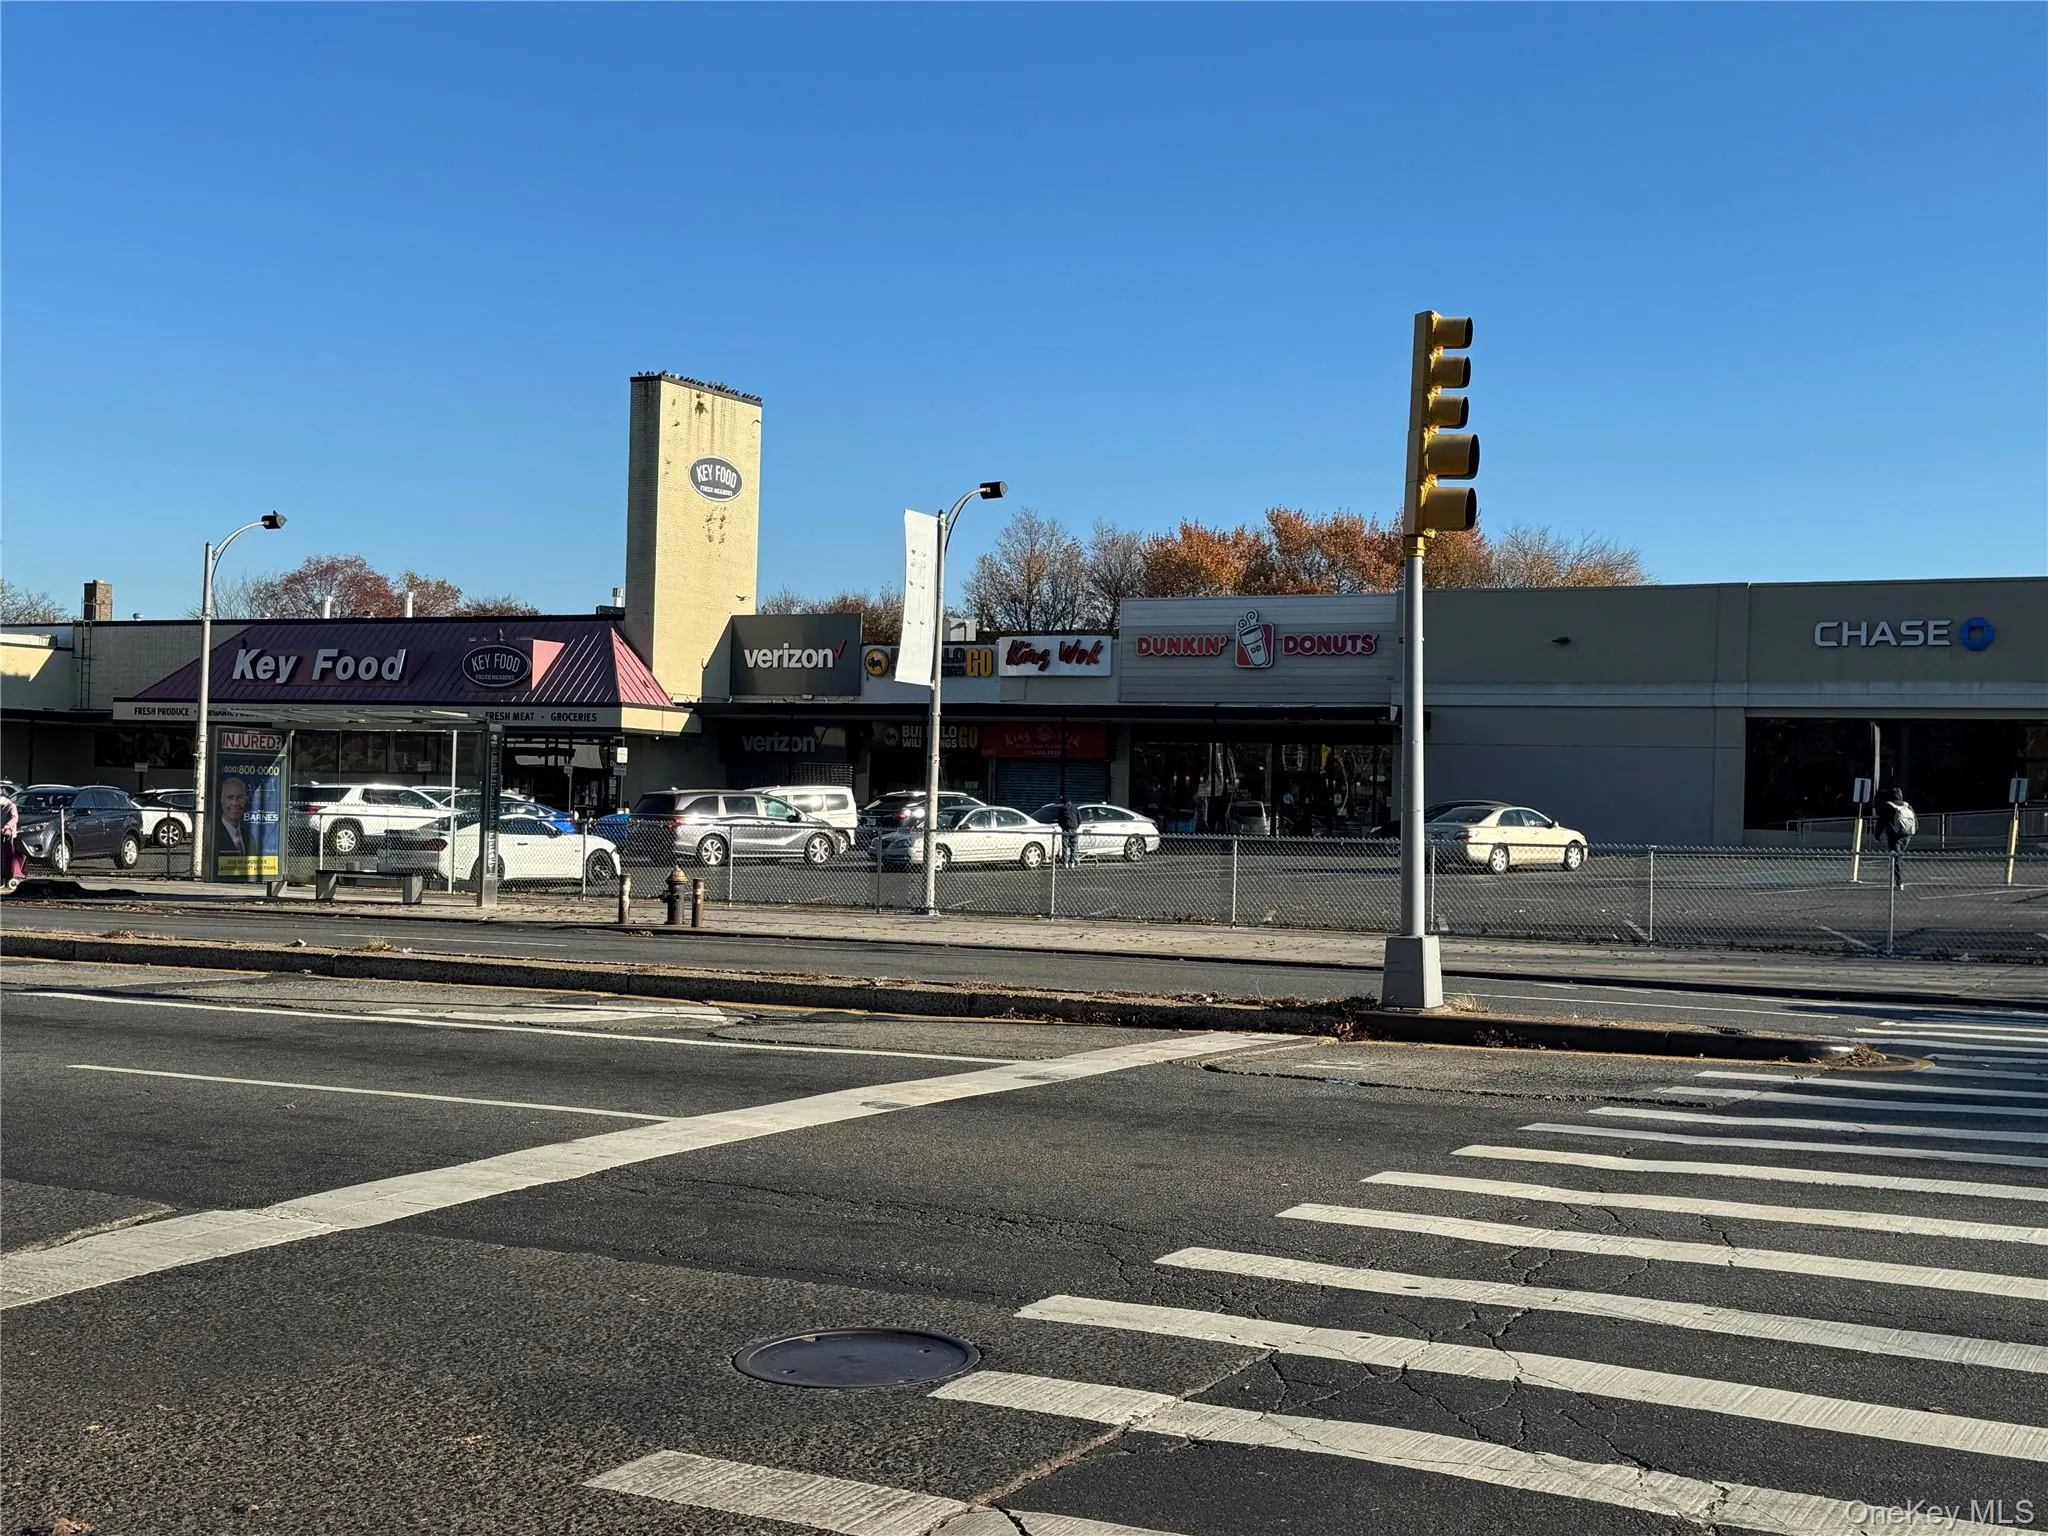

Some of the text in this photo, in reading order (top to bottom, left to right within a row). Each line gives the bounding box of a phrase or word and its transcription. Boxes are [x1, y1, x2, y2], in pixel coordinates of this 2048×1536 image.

[696, 464, 737, 488] KEY FOOD
[1136, 633, 1378, 656] DUNKIN' DONUTS
[1814, 620, 1952, 647] CHASE
[232, 648, 407, 684] Key Food
[471, 653, 520, 673] KEY FOOD
[743, 642, 834, 669] verizon
[966, 647, 994, 678] GO
[1006, 639, 1104, 672] King Wok
[134, 706, 156, 717] FRESH
[157, 706, 190, 717] PRODUCE
[485, 711, 598, 723] FRESH MEAT GROCERIES
[223, 733, 281, 750] INJURED?
[742, 731, 816, 753] verizon
[902, 725, 958, 738] BULO
[958, 726, 979, 749] GO
[243, 812, 279, 822] BARNES
